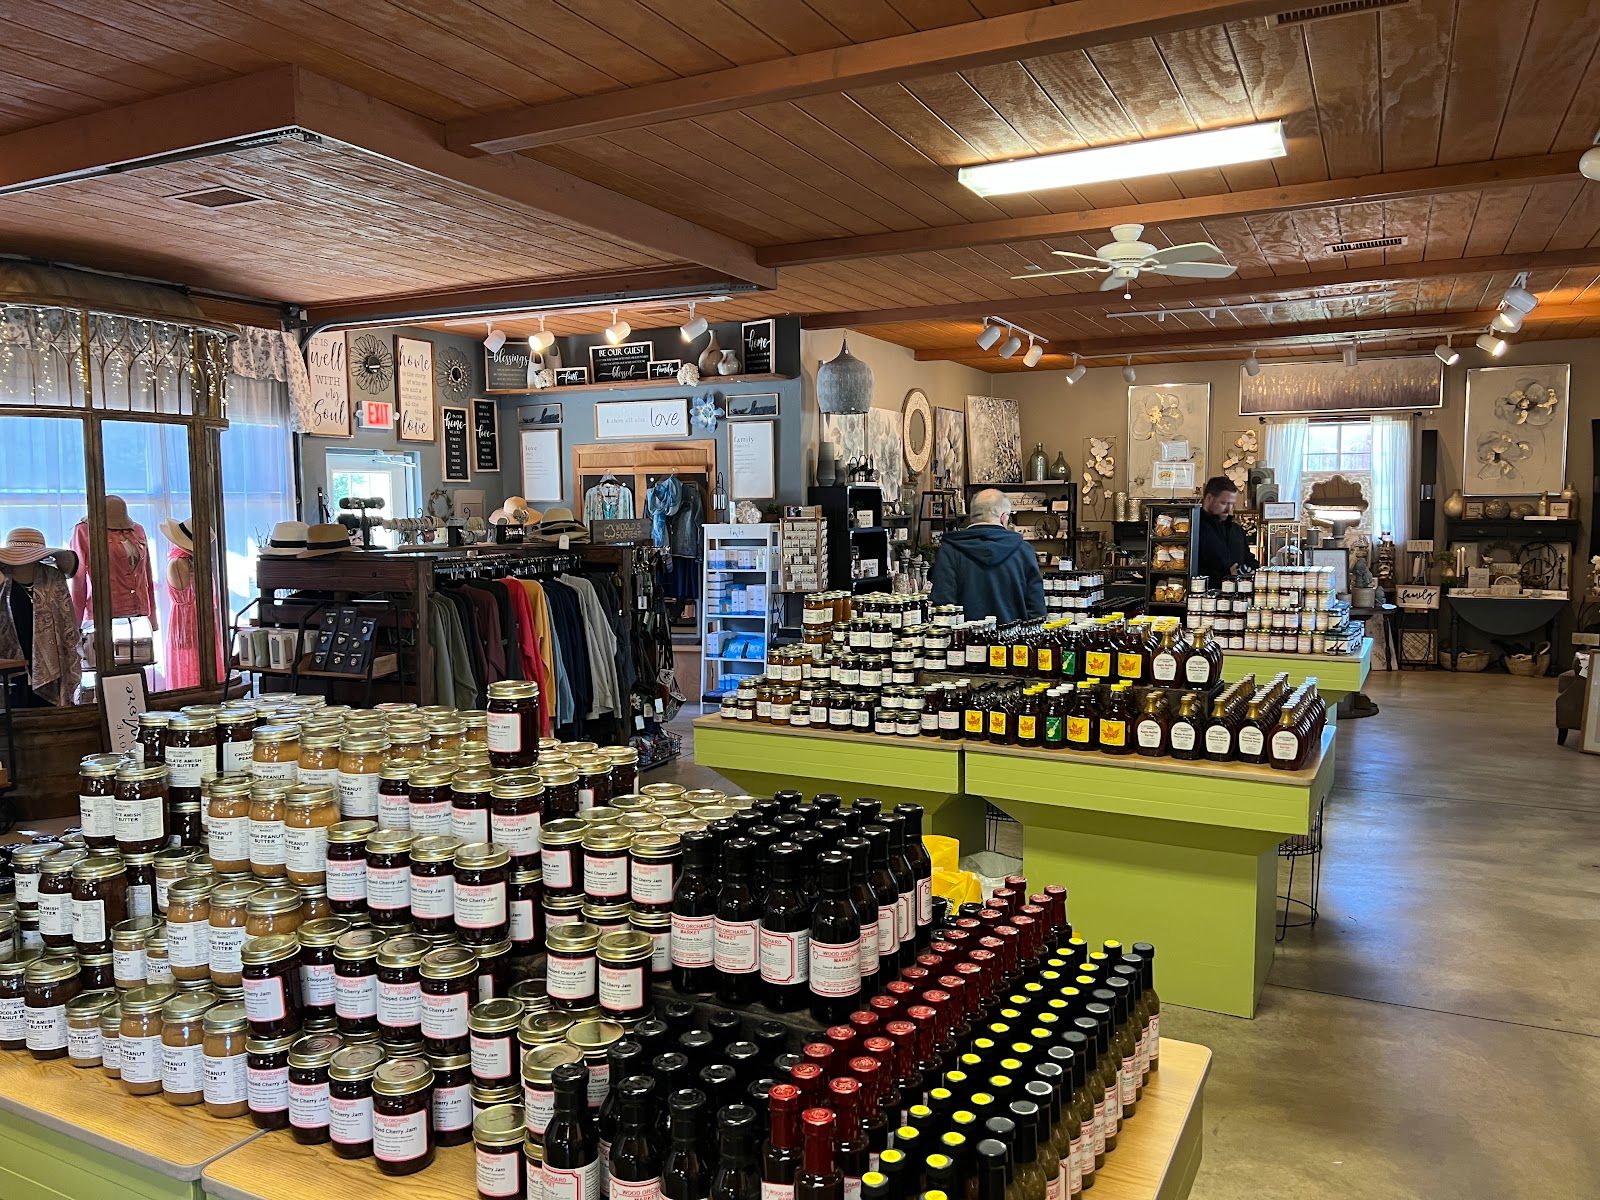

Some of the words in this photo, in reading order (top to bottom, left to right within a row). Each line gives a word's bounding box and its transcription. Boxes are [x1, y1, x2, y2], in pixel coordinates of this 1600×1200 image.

[320, 338, 329, 347] IS
[746, 329, 770, 351] home
[311, 341, 345, 371] well
[400, 345, 431, 372] home
[489, 347, 529, 369] blessings
[598, 349, 607, 357] BE
[607, 348, 623, 357] OUR
[624, 346, 645, 355] GUEST
[315, 375, 341, 386] WITH
[314, 398, 345, 426] Soul
[367, 402, 389, 426] EXIT
[402, 409, 429, 435] love
[444, 411, 466, 430] home
[650, 407, 680, 428] love
[1399, 588, 1438, 605] family
[833, 955, 854, 963] MARKET
[335, 1110, 350, 1118] Cherry
